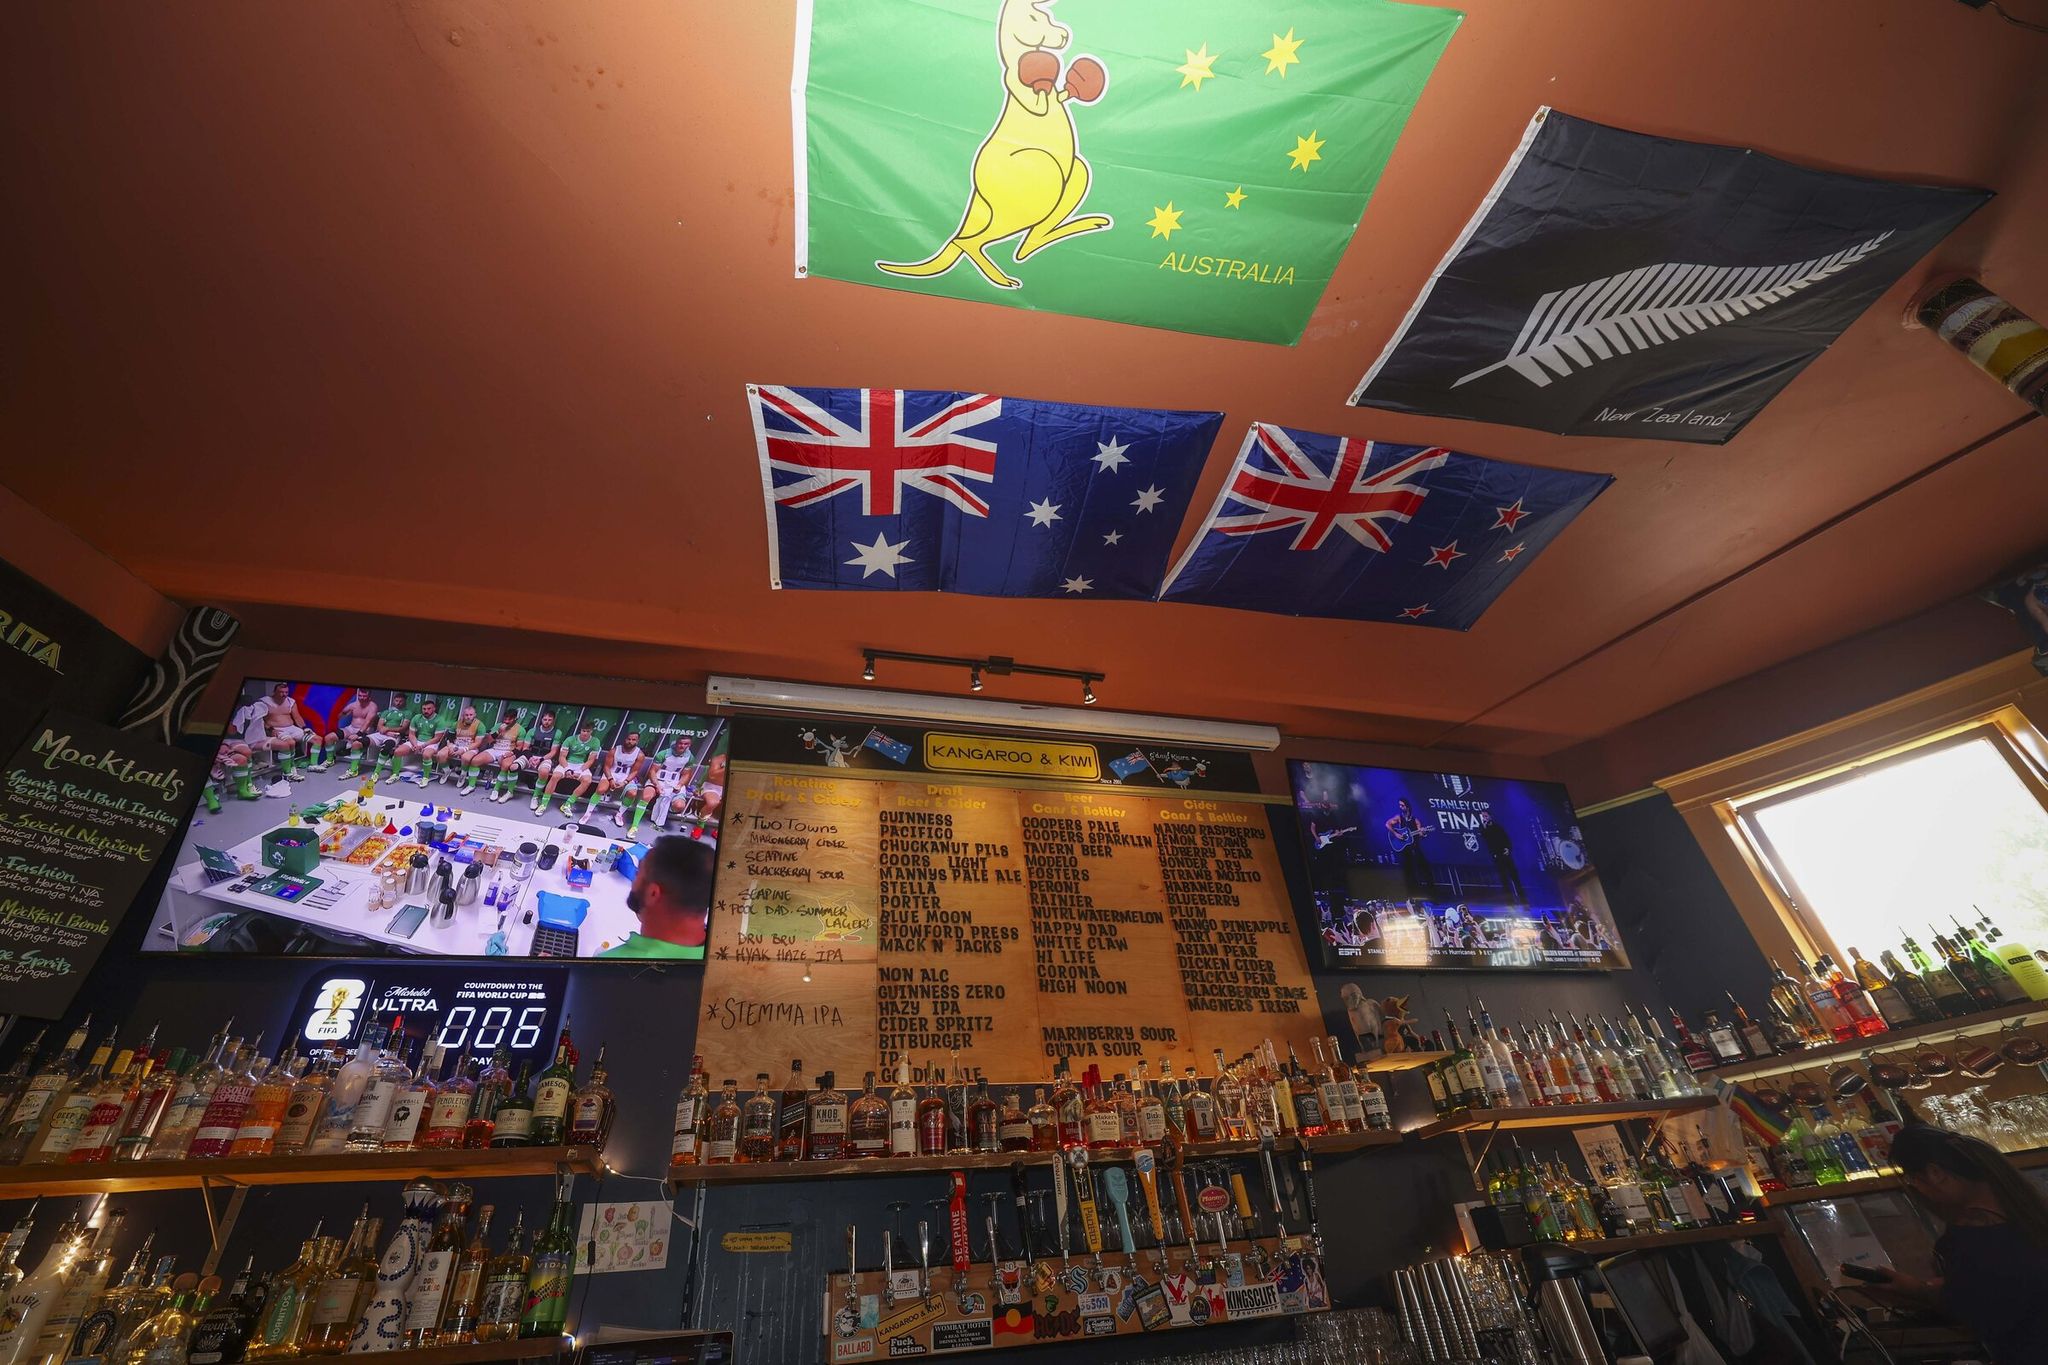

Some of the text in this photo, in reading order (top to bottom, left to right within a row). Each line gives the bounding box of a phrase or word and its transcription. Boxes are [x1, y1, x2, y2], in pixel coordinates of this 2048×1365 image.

[1159, 251, 1296, 286] AUSTRALIA
[1593, 407, 1731, 427] New Zealand
[445, 698, 457, 710] 16
[482, 701, 494, 714] 17
[649, 727, 709, 738] RUGBYPASS TV
[932, 745, 1093, 768] KANGAROO & KIWI
[32, 728, 184, 801] Mocktails
[774, 775, 838, 794] Rotating
[926, 784, 963, 795] Draft
[8, 768, 179, 827] Guava Red Bull Italian
[15, 784, 99, 814] Soda Guava
[746, 788, 792, 802] Drafts
[897, 795, 987, 809] Beer Cider
[1064, 792, 1093, 803] Beer
[8, 794, 116, 827] Red Bull Soda
[1032, 803, 1126, 818] Cans Bottles
[1183, 799, 1217, 811] Cider
[1428, 798, 1490, 811] STANLEY CUP
[879, 810, 953, 827] GUINNESS
[1160, 809, 1248, 823] Cans Bottles
[749, 815, 838, 834] Two Towns
[1022, 817, 1120, 833] COOPERS PALE
[1153, 823, 1266, 840] MANGO RASPBERRY
[14, 813, 152, 862] Social Network
[880, 825, 953, 840] PACIFICO
[1023, 829, 1152, 848] COOPERS SPARKLIN
[880, 839, 1009, 857] CHUCKANUT PILS
[1156, 833, 1248, 848] LEMON STRAWB
[745, 850, 799, 863] SEAPINE
[1023, 842, 1113, 857] TAVERN BEER
[1158, 844, 1253, 860] ELDBERRY PEAR
[880, 853, 988, 869] COORS LIGHT
[1024, 854, 1078, 868] MODELO
[1158, 856, 1242, 871] YONDER DRY
[6, 856, 78, 884] Fashion
[747, 864, 845, 882] BLACKBERRY SOUR
[879, 867, 1022, 882] MANNYS PALE ALE
[1027, 867, 1090, 881] FOSTERS
[1162, 868, 1261, 882] STRAWB MOJITO
[22, 885, 66, 900] orange
[35, 878, 75, 893] Herbal
[880, 881, 937, 894] STELLA
[1029, 880, 1080, 894] PERONI
[1163, 881, 1233, 894] HABANERO
[738, 888, 792, 901] SEAPINE
[880, 895, 941, 909] PORTER
[1029, 893, 1093, 908] RAINIER
[1167, 893, 1240, 907] BLUEBERRY
[0, 899, 110, 935] Mocktail Bomb
[729, 903, 848, 917] POOL SUMMER
[880, 910, 972, 923] BLUE MOON
[1031, 906, 1164, 924] NUTRL WATERMELON
[1169, 905, 1207, 918] PLUM
[0, 918, 88, 941] Mango Lemon
[880, 924, 1019, 940] STOWFORD PRESS
[1032, 920, 1118, 937] HAPPY DAD
[1172, 918, 1290, 934] MANGO PINEAPPLE
[771, 933, 796, 945] BRU
[1033, 935, 1128, 952] WHITE CLAW
[1180, 930, 1258, 945] TART APPLE
[880, 938, 1002, 953] MACK N JACKS
[1176, 942, 1258, 958] ASIAN PEAR
[1338, 948, 1362, 956] ESPN
[19, 949, 72, 975] Spritz
[735, 948, 844, 965] HYAK HAZE IPA
[1036, 950, 1096, 964] HI LIFE
[1178, 956, 1276, 972] DICKEN CIDER
[879, 967, 949, 983] NON ALC
[1037, 964, 1100, 979] CORONA
[1180, 969, 1278, 985] PRICKLY PEAR
[384, 986, 430, 998] Michelob
[464, 982, 518, 990] COUNTDOWN
[878, 985, 1005, 999] GUINNESS ZERO
[1040, 979, 1127, 994] HIGH NOON
[1183, 982, 1308, 1000] BLACKBERRY SAGE
[477, 991, 509, 999] WORLD
[372, 998, 439, 1012] ULTRA
[878, 1001, 961, 1016] HAZY IPA
[1188, 998, 1301, 1013] MAGNERS IRISH
[721, 997, 844, 1031] STEMMA IPA
[436, 1006, 547, 1048] 006
[878, 1016, 993, 1032] CIDER SPRITZ
[879, 1033, 973, 1049] BITBURGER
[1042, 1026, 1177, 1042] MARNBERRY SOUR
[1045, 1042, 1143, 1057] GUAVA SOUR
[816, 1108, 838, 1119] KNOB
[952, 1210, 963, 1263] SEAPINE
[1226, 1285, 1276, 1310] KINGSCLIFF
[270, 1295, 291, 1343] HORNITOS
[879, 1313, 920, 1336] KANGAROO
[934, 1321, 990, 1331] WOMBAT HOTEL
[837, 1341, 871, 1356] BALLARD
[890, 1337, 914, 1347] Fuck
[890, 1345, 926, 1356] Racism.
